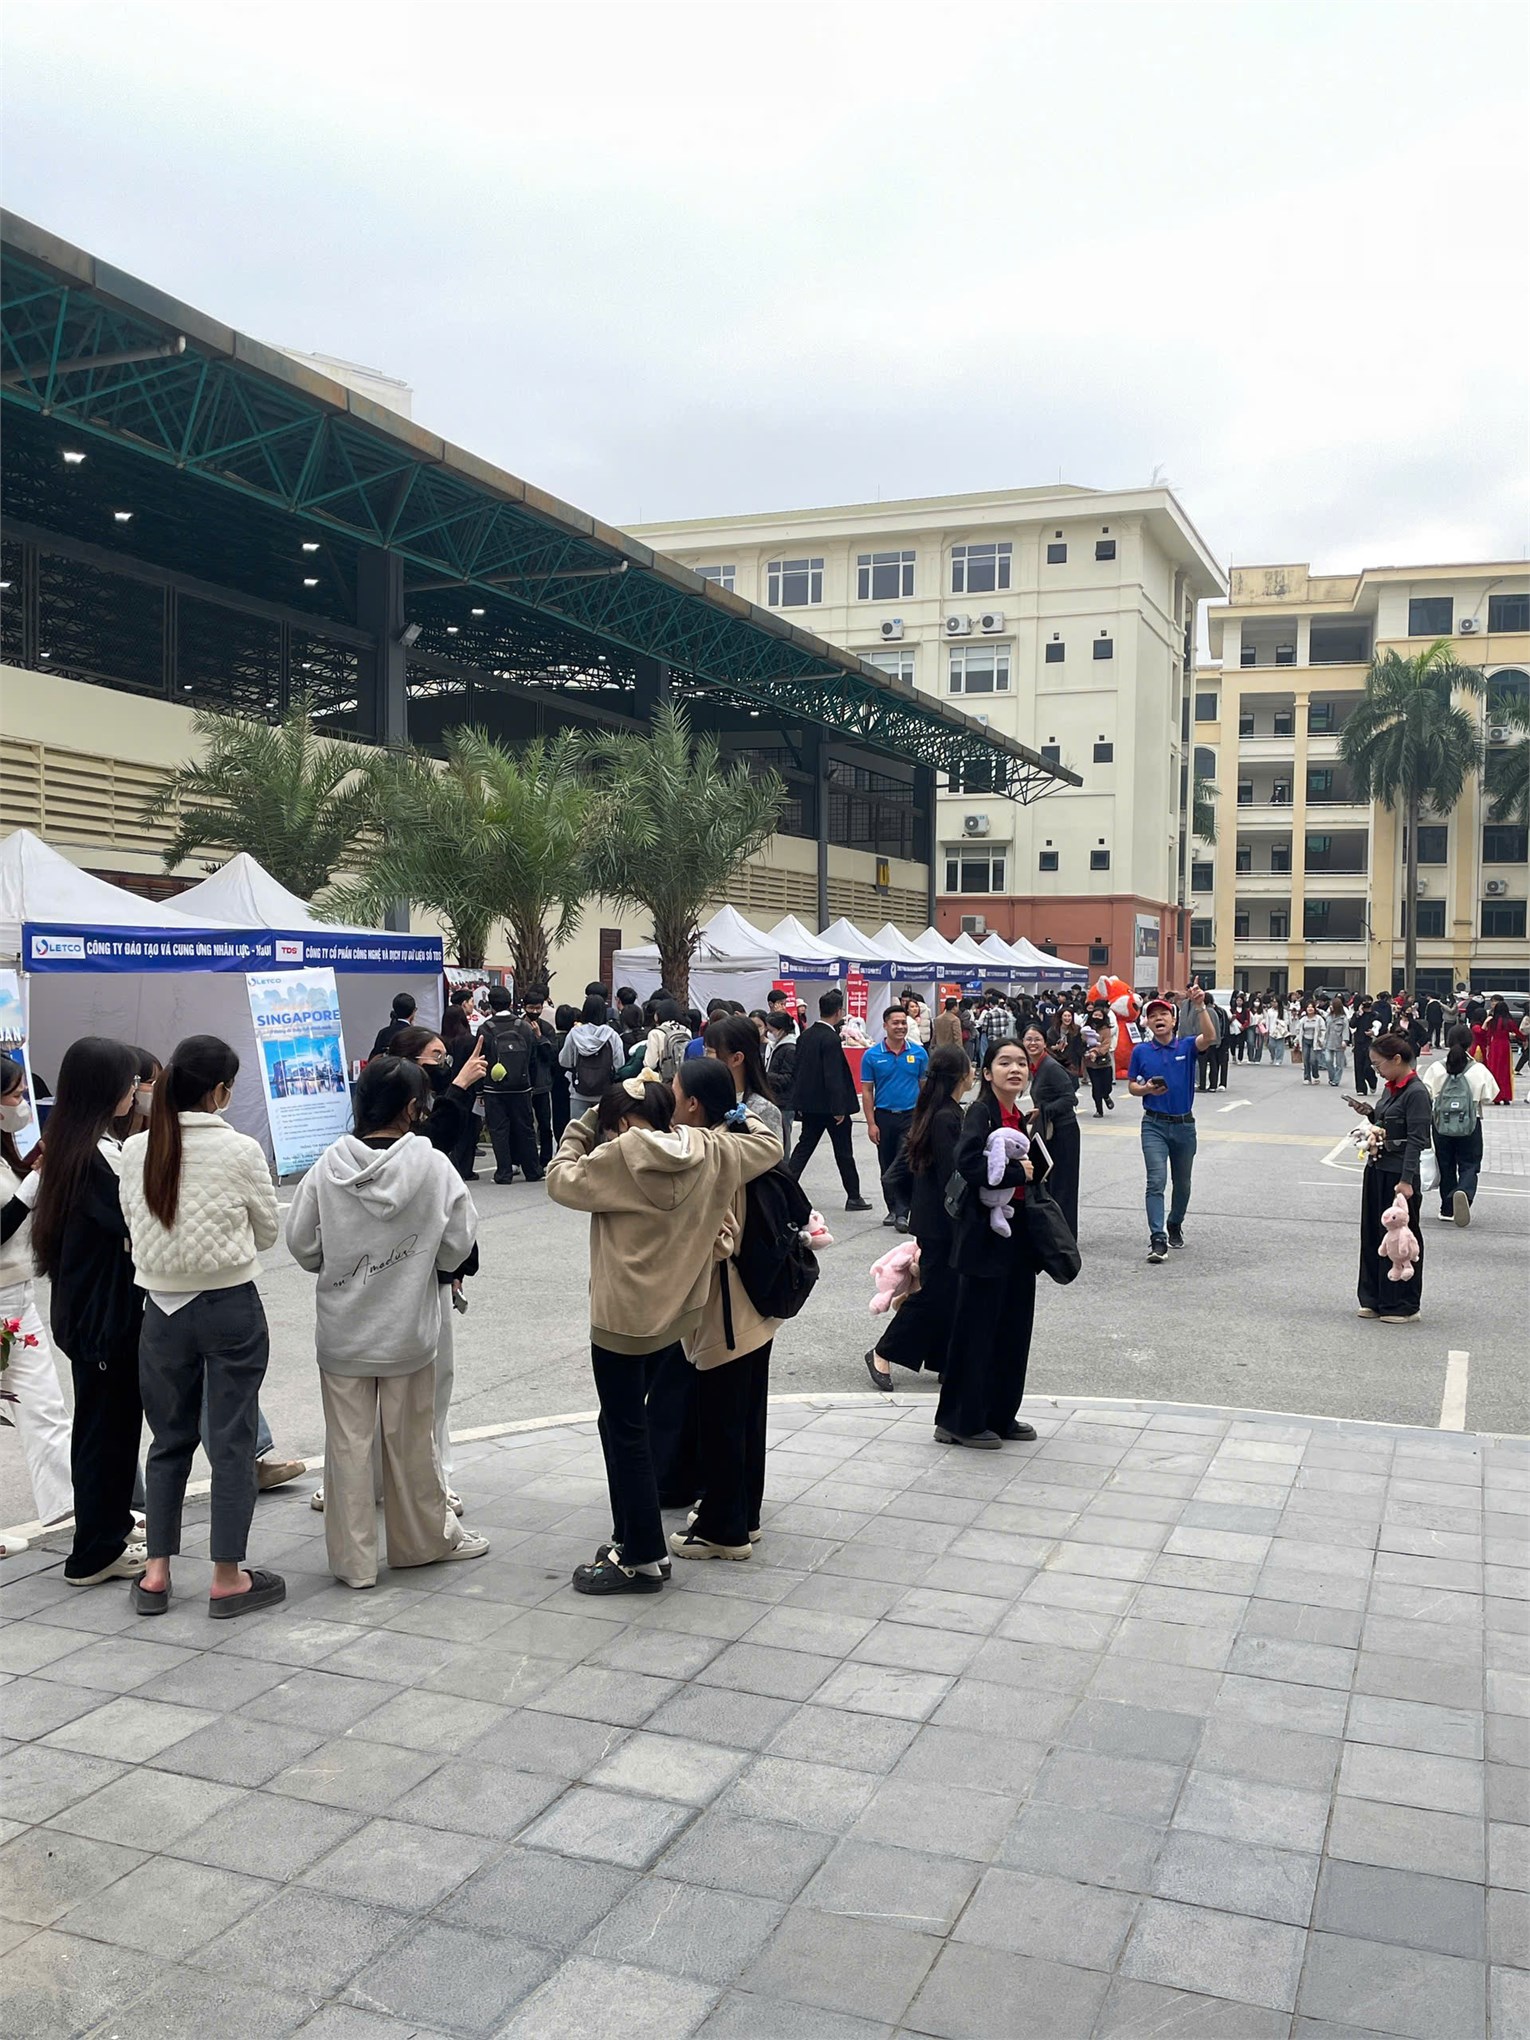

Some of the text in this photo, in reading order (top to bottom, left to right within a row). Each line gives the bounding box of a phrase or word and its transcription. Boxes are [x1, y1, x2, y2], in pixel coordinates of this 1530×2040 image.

[49, 944, 81, 953] LETCO
[86, 940, 111, 955] CÔNG
[112, 942, 123, 955] TY
[124, 941, 142, 956] ĐÀO
[144, 943, 159, 958] TẠO
[161, 942, 171, 956] VÀ
[173, 944, 194, 956] CUNG
[196, 942, 212, 957] ỨNG
[213, 942, 234, 957] NHÂN
[236, 943, 250, 959] LỰC
[281, 947, 298, 955] TDS
[305, 945, 321, 959] CÔNG
[321, 947, 329, 959] TY
[353, 946, 367, 960] CÔNG
[382, 948, 388, 960] VÀ
[433, 951, 442, 961] TDS
[257, 1009, 341, 1027] SINGAPORE
